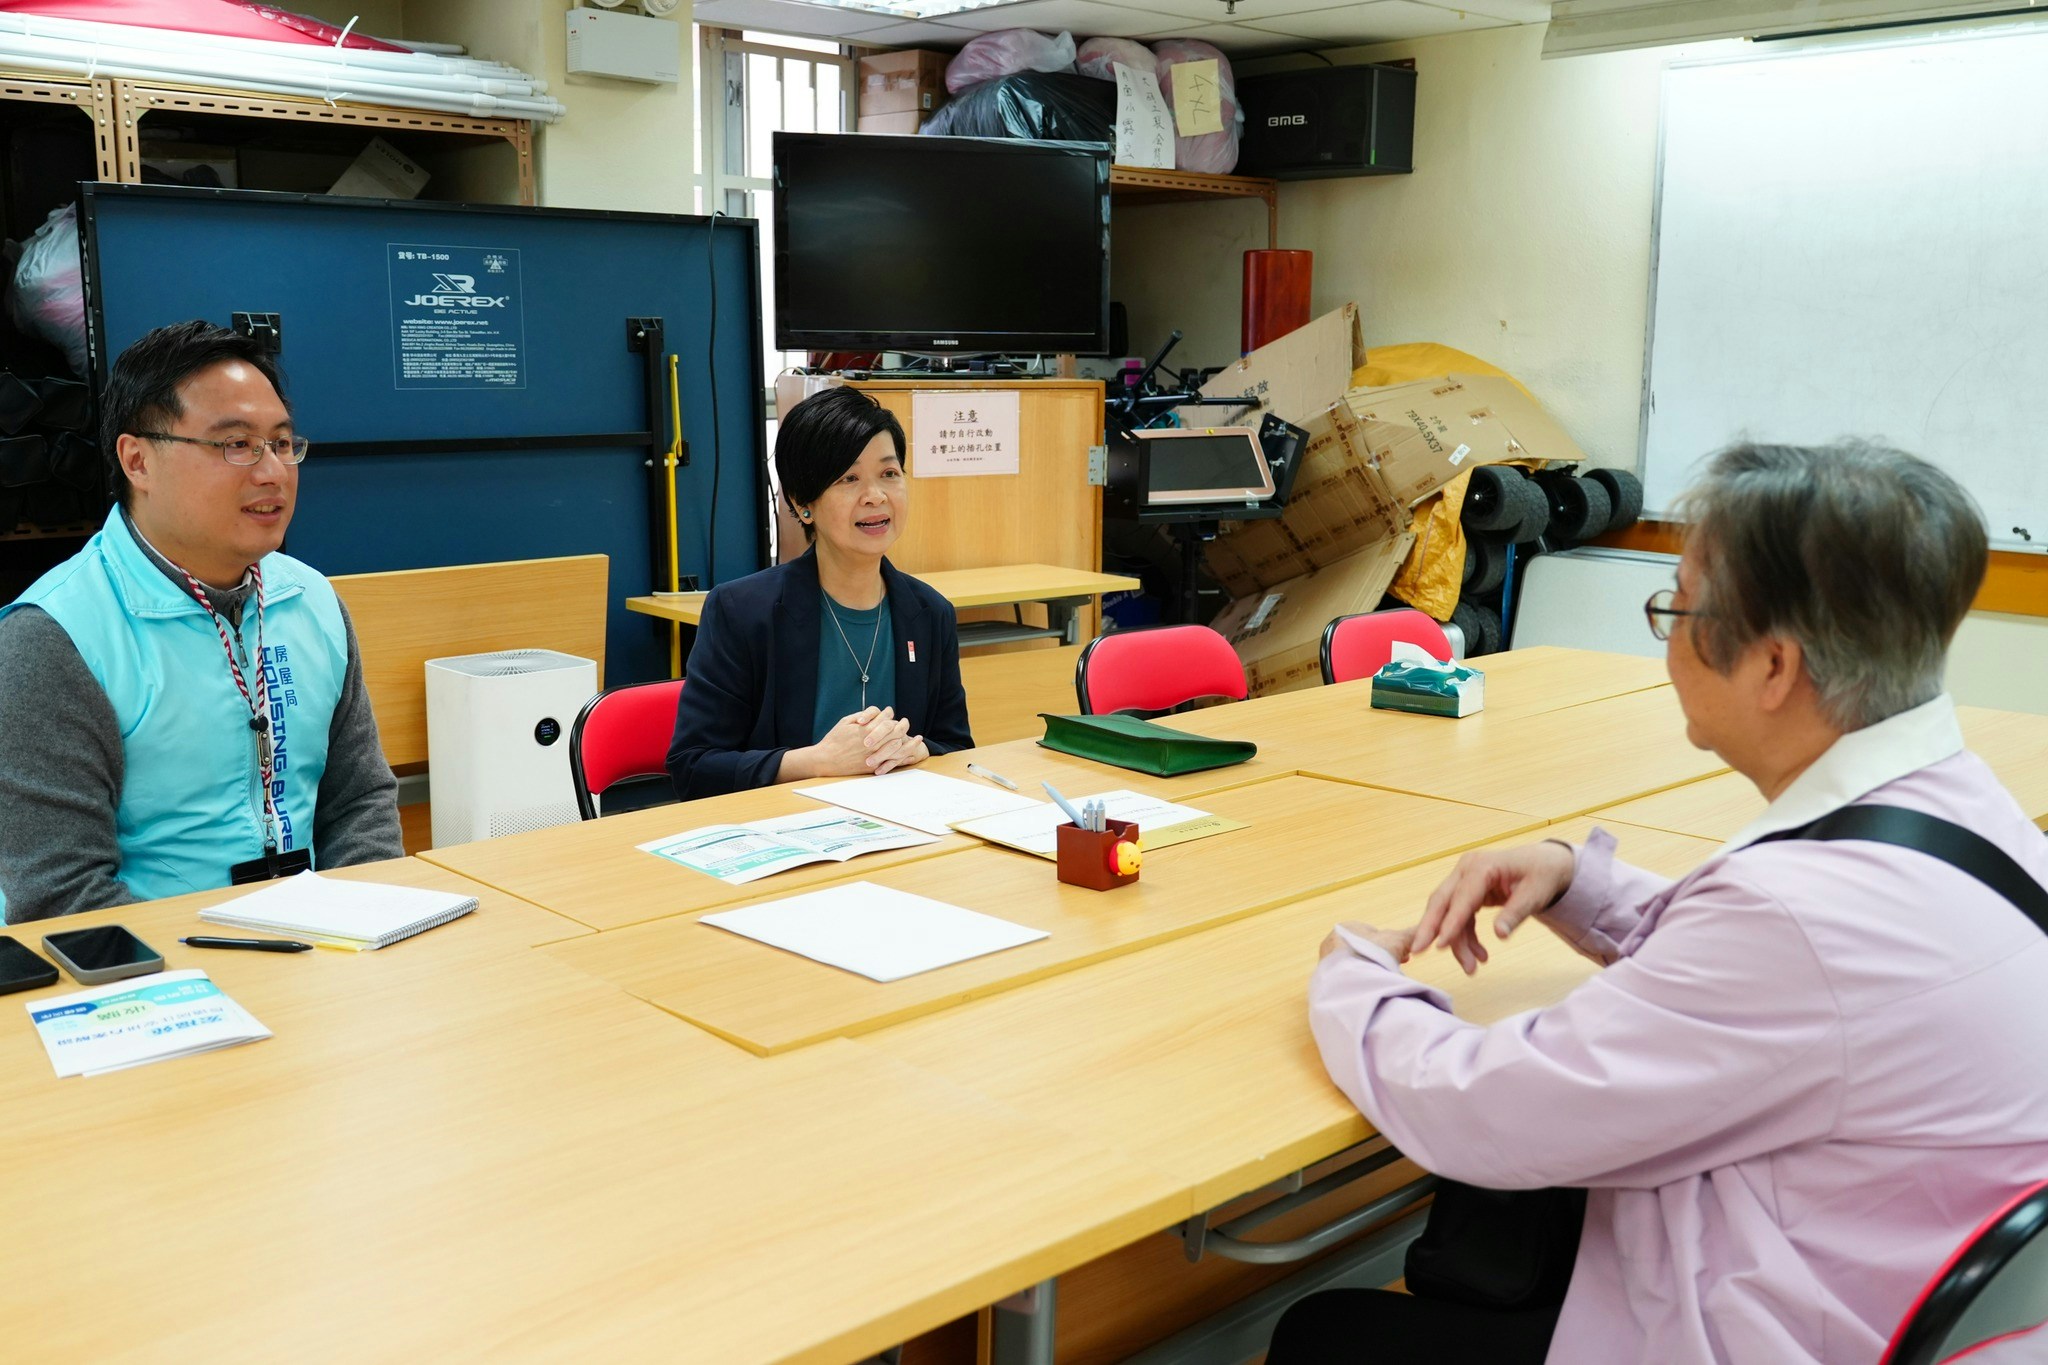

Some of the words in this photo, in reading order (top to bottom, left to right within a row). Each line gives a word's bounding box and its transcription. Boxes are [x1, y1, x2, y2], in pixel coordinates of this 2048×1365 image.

[1188, 73, 1214, 126] 4XL
[1268, 115, 1305, 127] BMB
[404, 294, 506, 308] JOEREX
[953, 409, 979, 423] 注意
[939, 428, 993, 439] 請勿自行改動
[930, 442, 1002, 455] 音響上的插孔位置
[1102, 594, 1123, 610] Double
[1123, 591, 1129, 599] A
[274, 644, 298, 708] 房屋局
[260, 646, 288, 773] HOUSING
